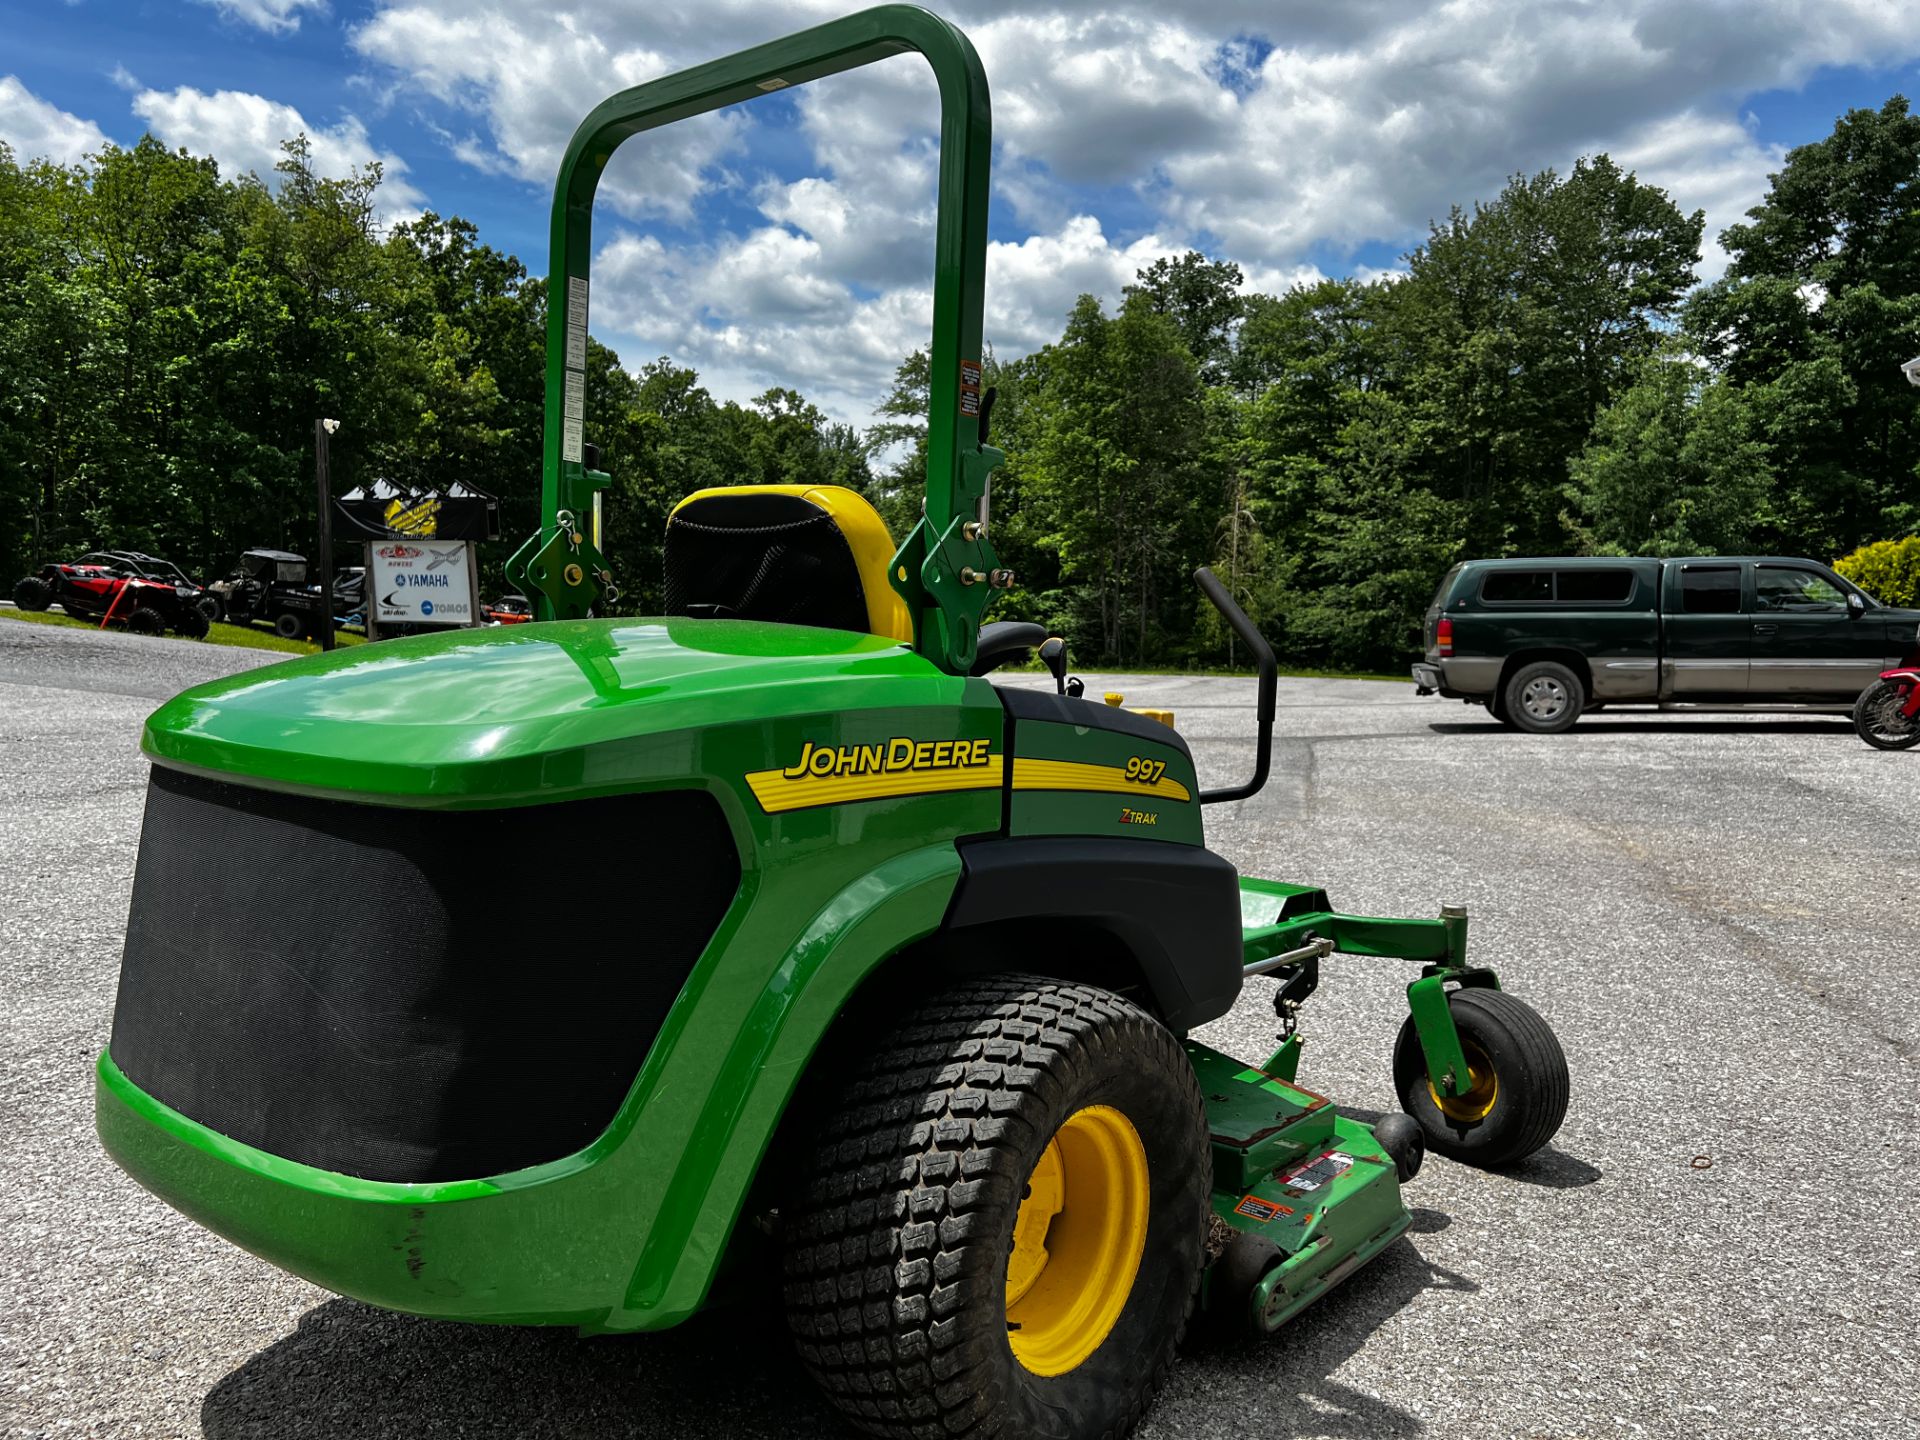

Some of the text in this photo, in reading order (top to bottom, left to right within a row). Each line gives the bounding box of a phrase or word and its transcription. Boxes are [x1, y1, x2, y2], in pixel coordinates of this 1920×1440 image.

[408, 574, 449, 588] YAMAHA
[434, 603, 468, 613] TOMOS
[783, 737, 991, 780] JOHN DEERE
[1125, 755, 1167, 784] 997
